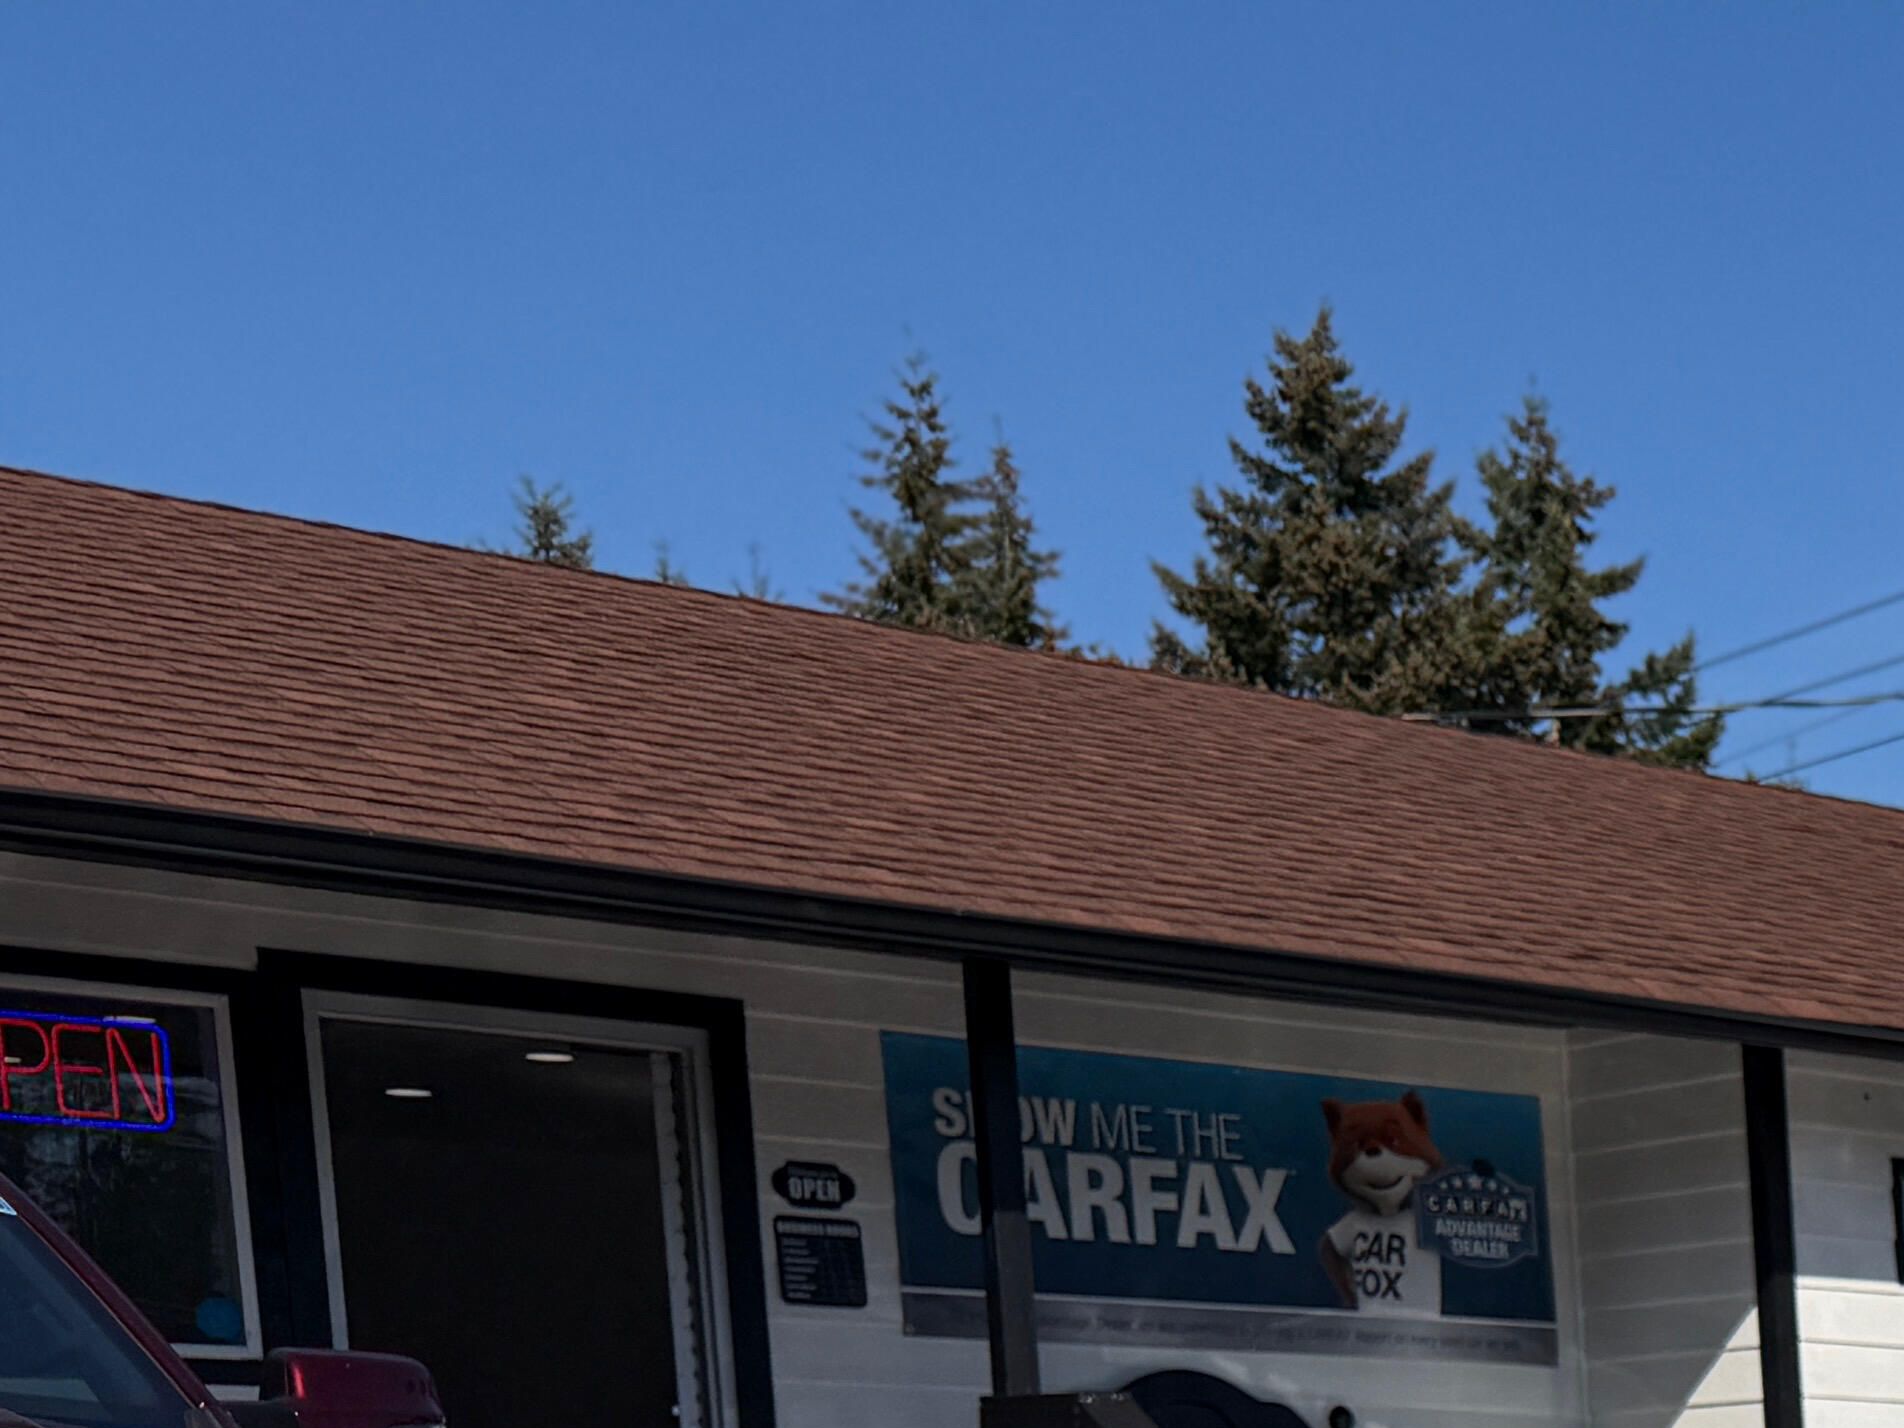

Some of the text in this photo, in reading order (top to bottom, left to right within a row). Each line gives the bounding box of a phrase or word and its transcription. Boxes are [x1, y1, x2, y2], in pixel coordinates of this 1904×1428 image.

[0, 1018, 165, 1123] PEN
[932, 1087, 1243, 1160] SW ME THE
[788, 1176, 842, 1203] OPEN
[937, 1141, 1296, 1255] CARFAX
[1435, 1219, 1521, 1241] ADVANTAGE
[1353, 1231, 1407, 1266] CAR
[1452, 1238, 1509, 1259] DEALER
